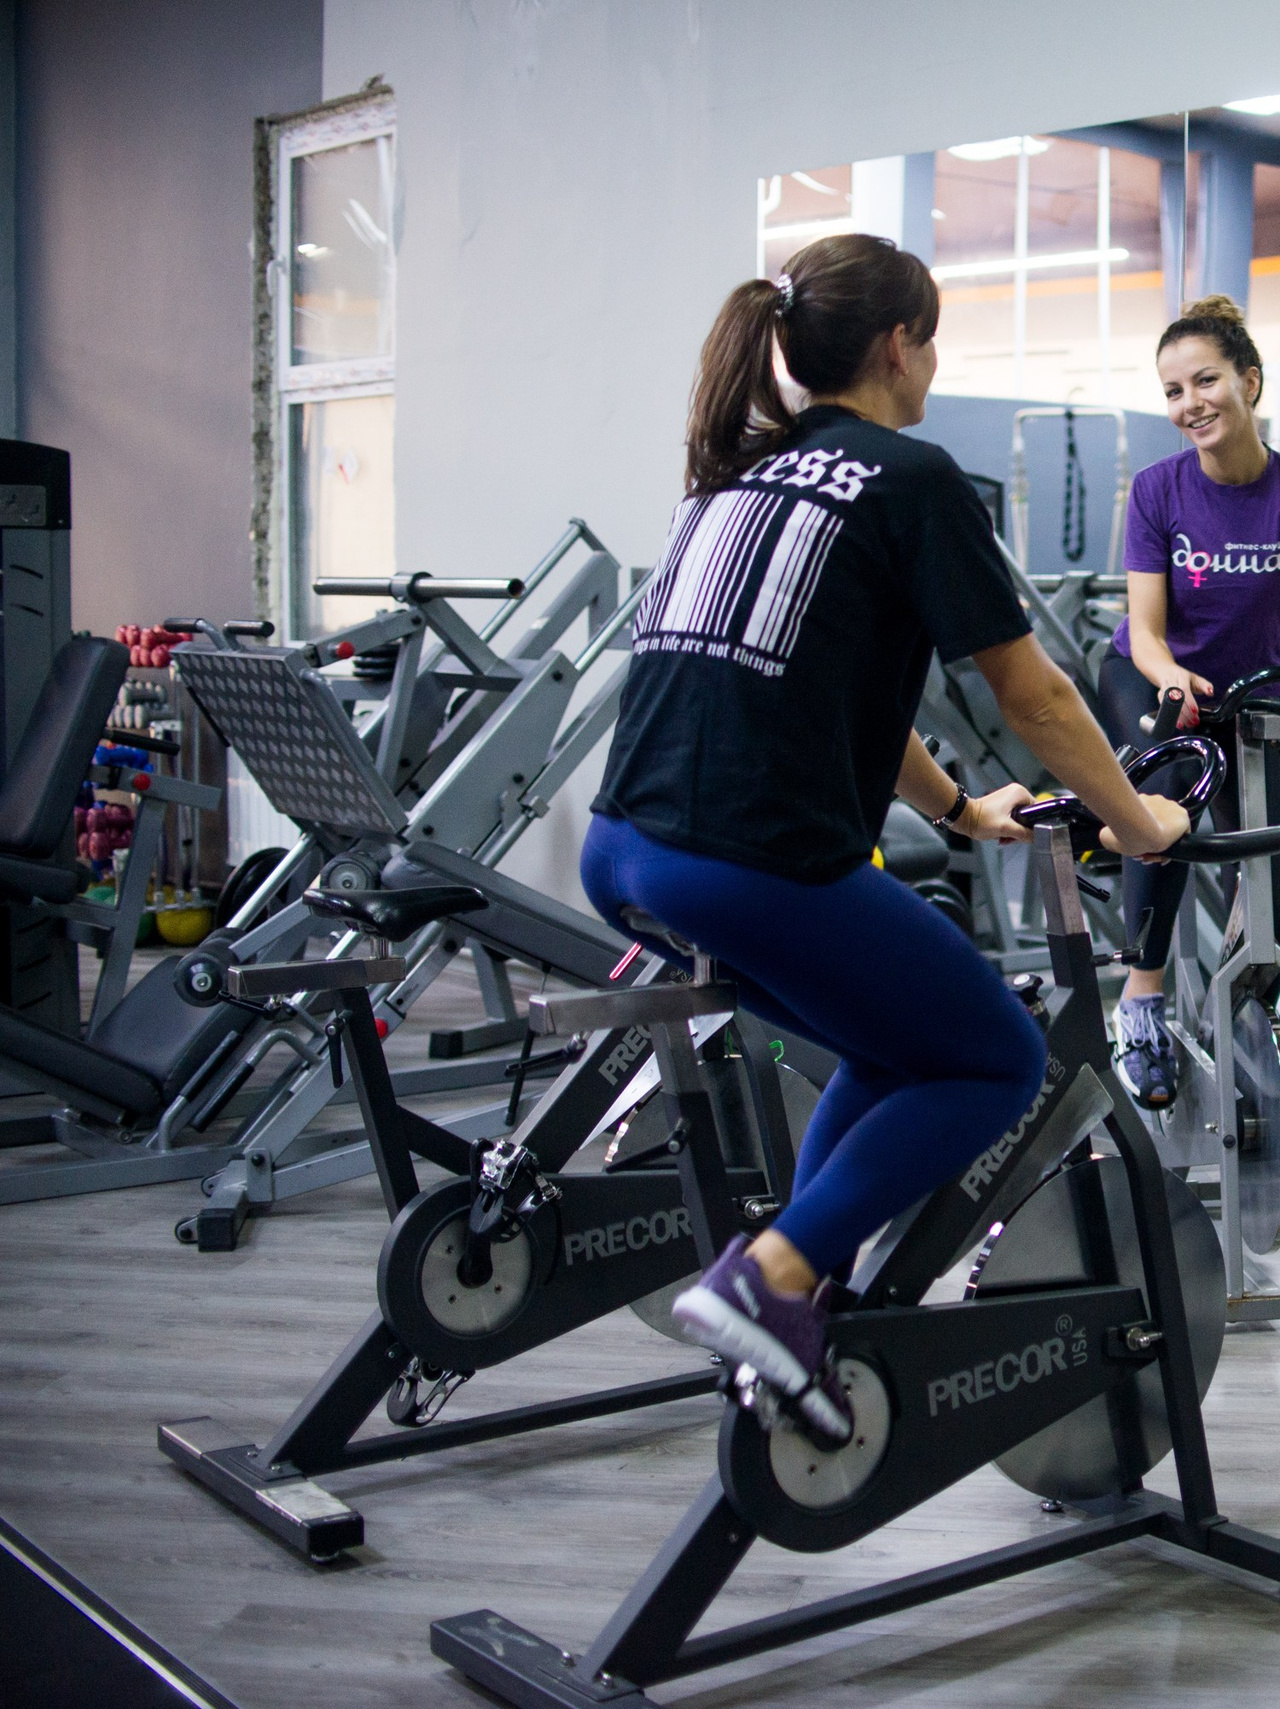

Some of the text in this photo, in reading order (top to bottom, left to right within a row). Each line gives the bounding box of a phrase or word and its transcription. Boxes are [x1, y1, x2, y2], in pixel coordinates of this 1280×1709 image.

[661, 634, 680, 651] life
[681, 638, 703, 654] are
[706, 641, 730, 659] not
[732, 646, 786, 677] things
[959, 1078, 1056, 1203] PREC
[564, 1207, 694, 1266] PRECOR
[1071, 1326, 1088, 1367] USA
[927, 1337, 1068, 1417] PRECOR
